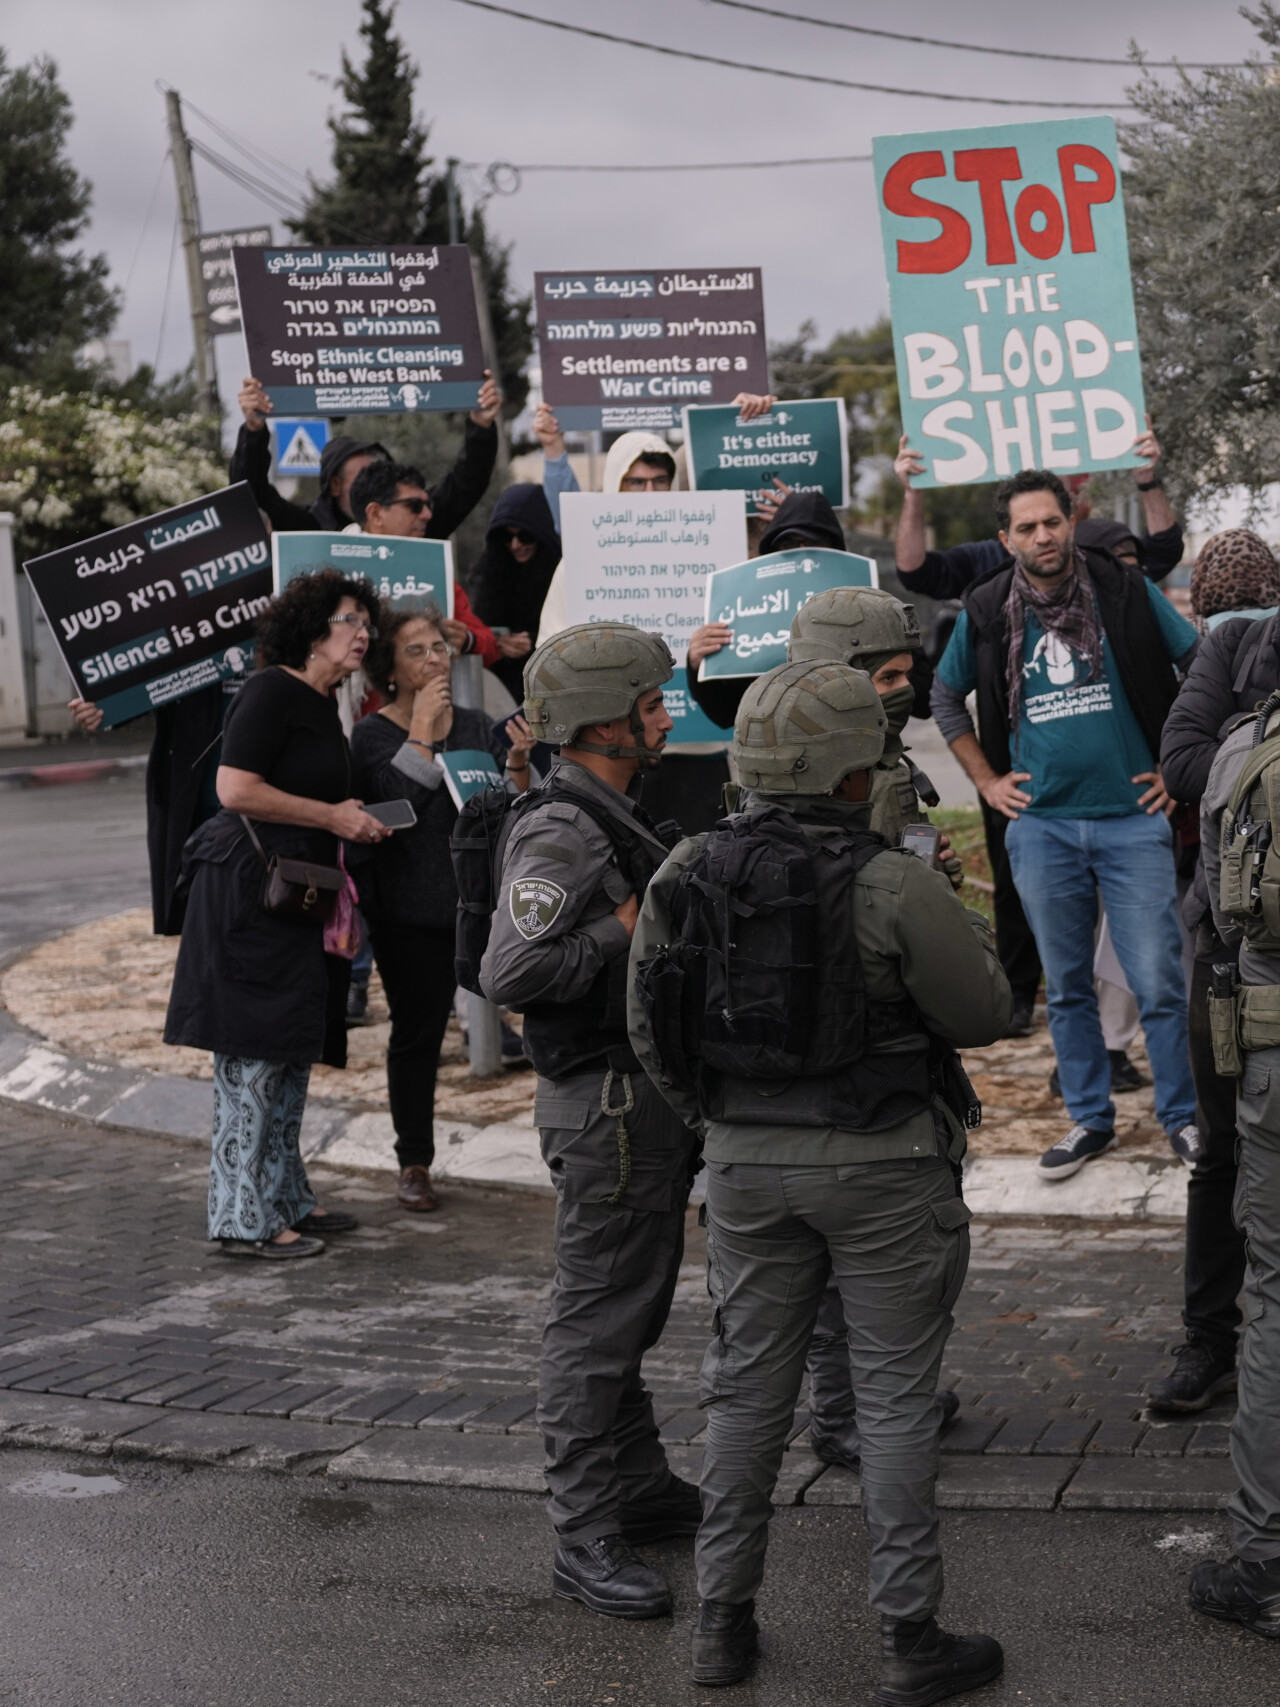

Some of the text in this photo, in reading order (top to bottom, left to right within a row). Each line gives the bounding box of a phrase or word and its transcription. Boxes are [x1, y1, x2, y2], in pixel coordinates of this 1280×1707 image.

[882, 143, 1116, 275] STOP
[267, 247, 439, 272] أوقفوا التطهير العرقي
[287, 272, 426, 291] في الضفة الغربية
[543, 272, 754, 299] الاستيطان جريمة حرب
[963, 273, 1061, 315] THE
[283, 298, 437, 317] הפסיקו את טרור
[286, 317, 441, 337] המתנחלים בגדה
[547, 317, 757, 340] התנחליות פשע מלחמה
[271, 347, 464, 368] Stop Ethnic Cleansing
[561, 355, 748, 375] Settlements are a
[903, 319, 1135, 400] BLOOD-
[295, 366, 443, 385] in the West Bank
[601, 377, 712, 397] War Crime
[722, 432, 812, 452] It's either
[921, 388, 1137, 485] SHED
[719, 450, 819, 469] Democracy
[75, 506, 222, 579] الصمت جريمة
[602, 563, 716, 578] הפסיקו את הטיהור
[60, 540, 268, 642] שתיקה היא פשע
[585, 587, 650, 601] המתנחלים
[654, 586, 688, 599] וטרור
[622, 614, 662, 629] Ethnic
[81, 634, 172, 685] Silence
[171, 625, 196, 648] is
[198, 619, 215, 639] a
[215, 595, 270, 629] Crim
[1028, 707, 1074, 724] OMBATANTS
[1074, 705, 1090, 715] FOR
[457, 770, 487, 784] הים
